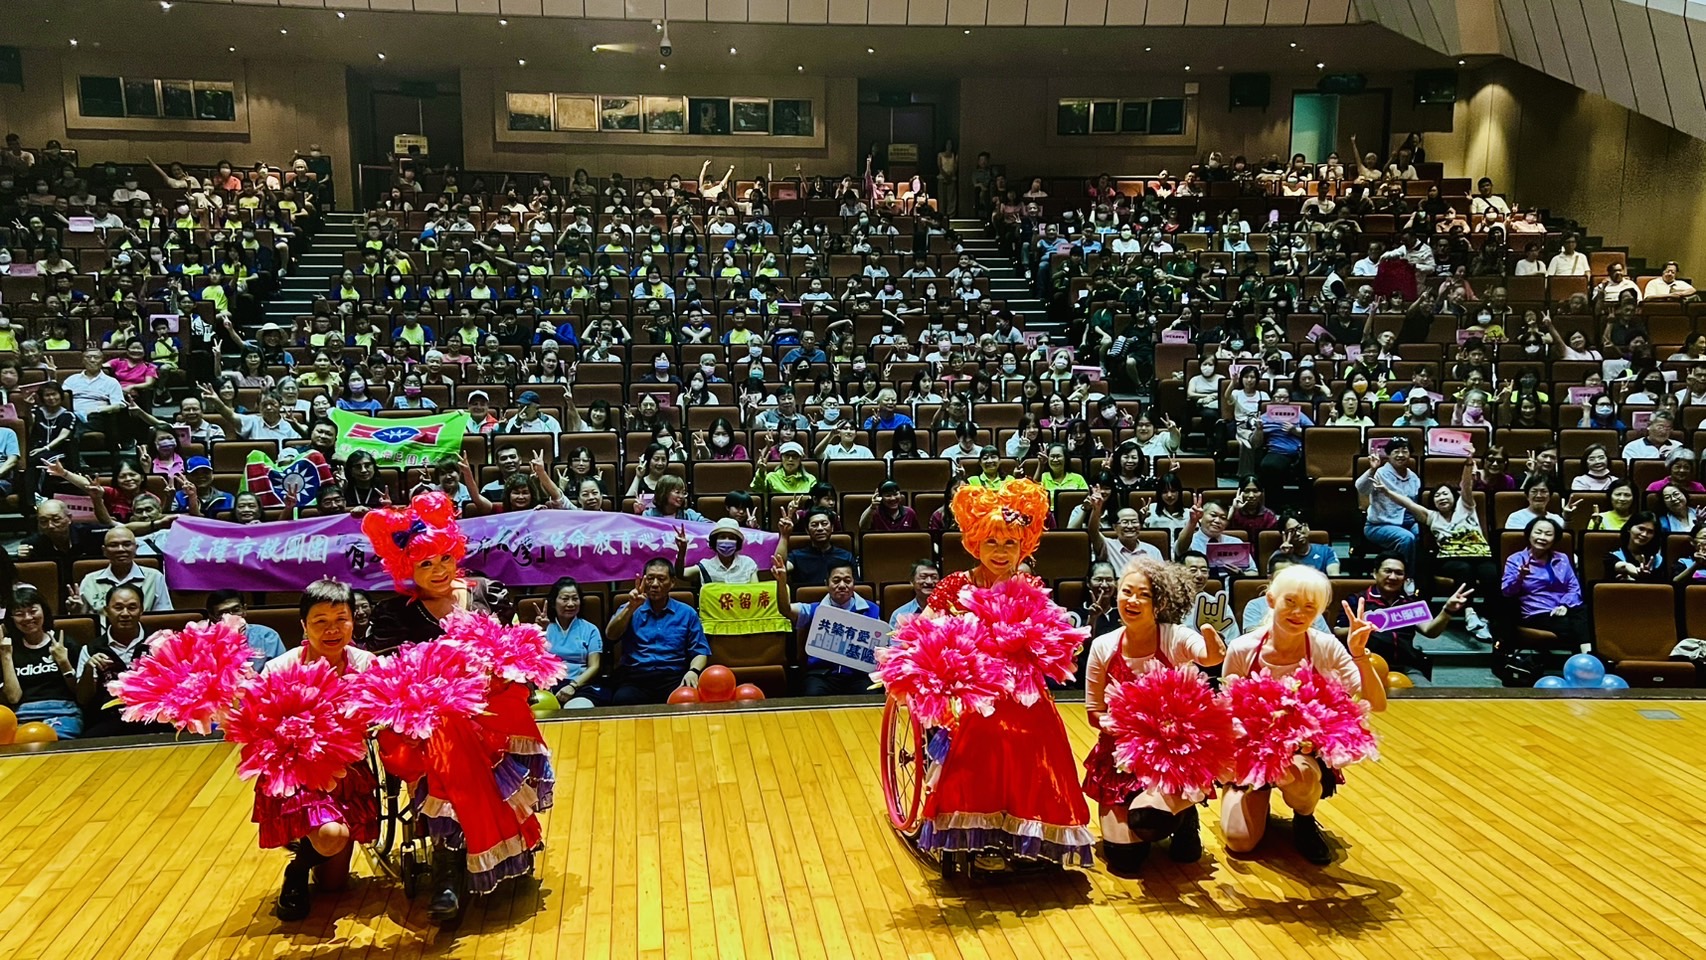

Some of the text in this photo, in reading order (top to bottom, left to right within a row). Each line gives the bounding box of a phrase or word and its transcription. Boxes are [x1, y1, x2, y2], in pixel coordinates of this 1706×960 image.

[719, 590, 771, 611] 保留席
[818, 618, 871, 644] 共築有愛
[845, 643, 877, 665] 基隆
